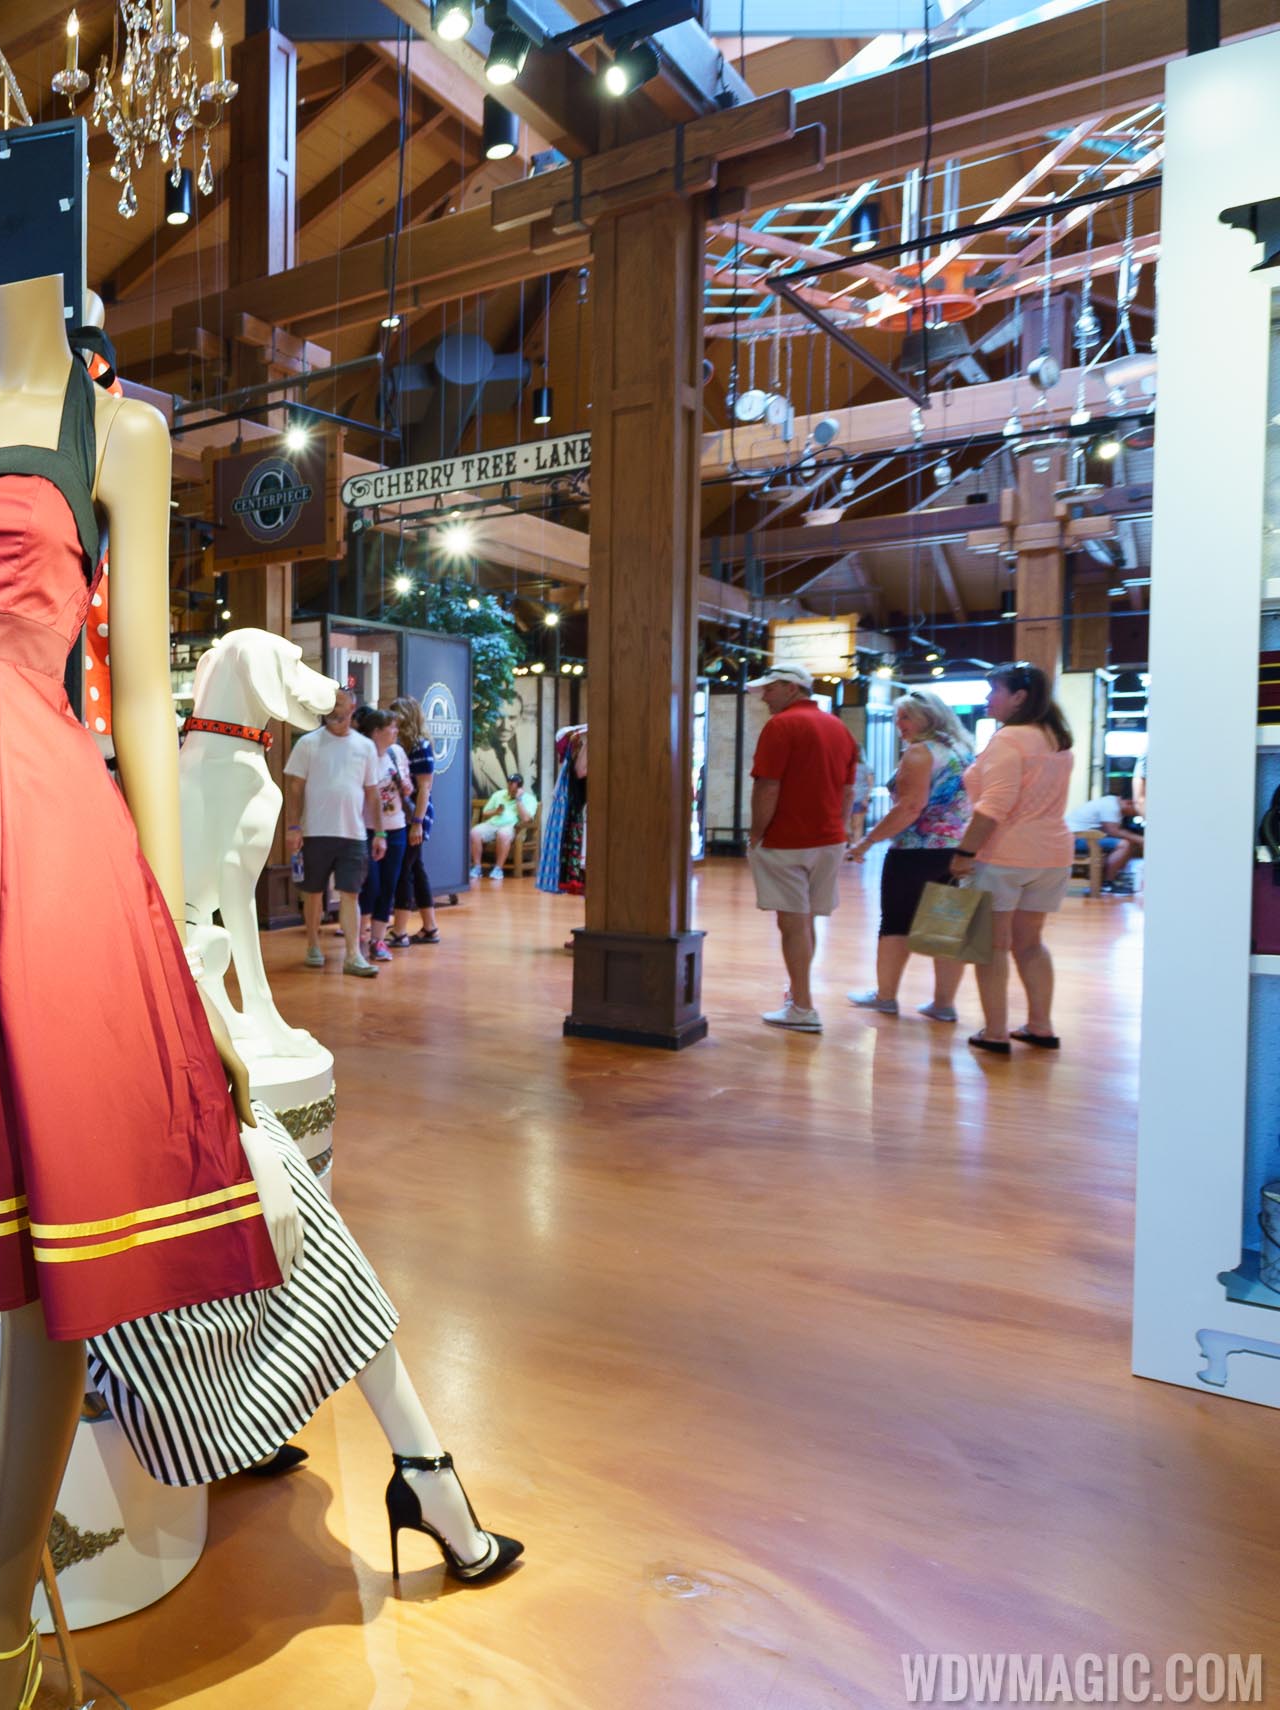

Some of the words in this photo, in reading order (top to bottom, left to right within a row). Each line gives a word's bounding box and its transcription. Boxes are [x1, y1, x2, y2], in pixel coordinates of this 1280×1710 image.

[373, 460, 455, 499] CHERRY
[461, 451, 517, 484] TREE
[535, 437, 591, 472] LANE
[234, 487, 309, 513] CENTERPIECE
[430, 723, 460, 735] TERPIECE
